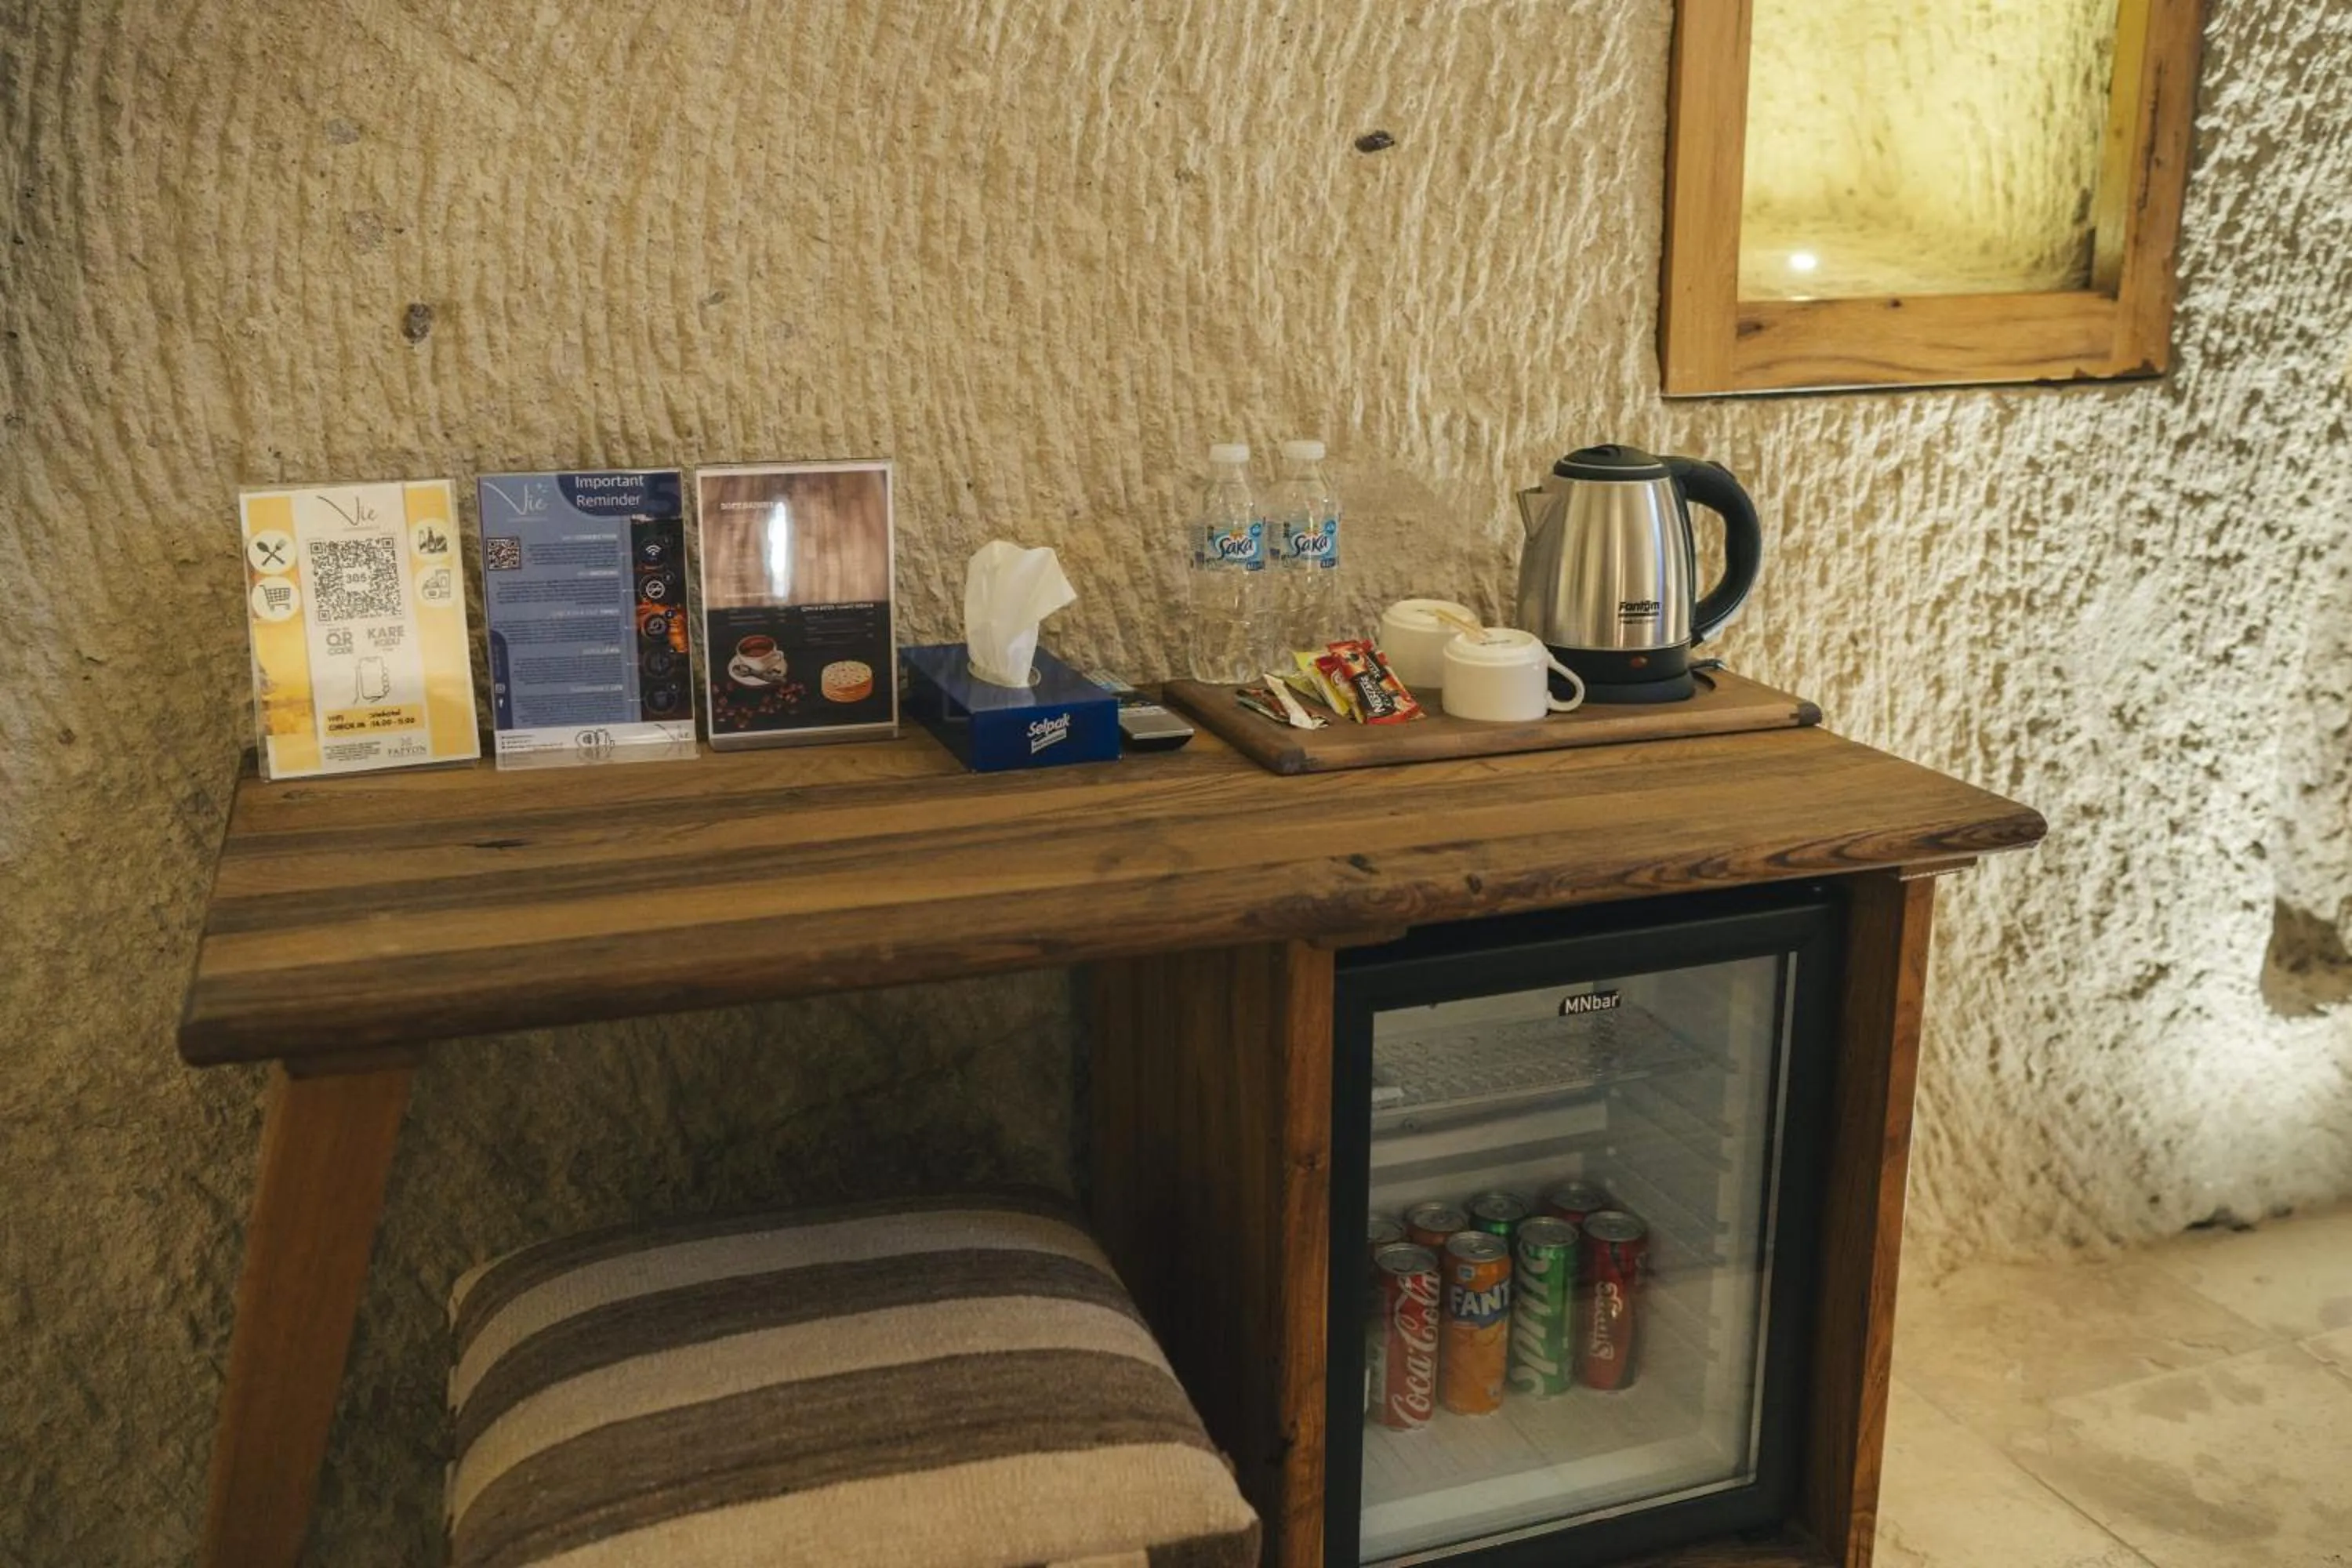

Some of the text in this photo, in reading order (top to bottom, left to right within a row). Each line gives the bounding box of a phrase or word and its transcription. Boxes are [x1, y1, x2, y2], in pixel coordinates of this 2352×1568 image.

[575, 474, 644, 490] Important
[483, 482, 549, 516] Vie
[576, 494, 641, 508] Reminder
[326, 631, 353, 647] QR
[367, 626, 405, 639] KARE
[1027, 713, 1070, 737] Selpak
[1565, 993, 1619, 1014] MNbar
[1450, 1279, 1511, 1316] FANT
